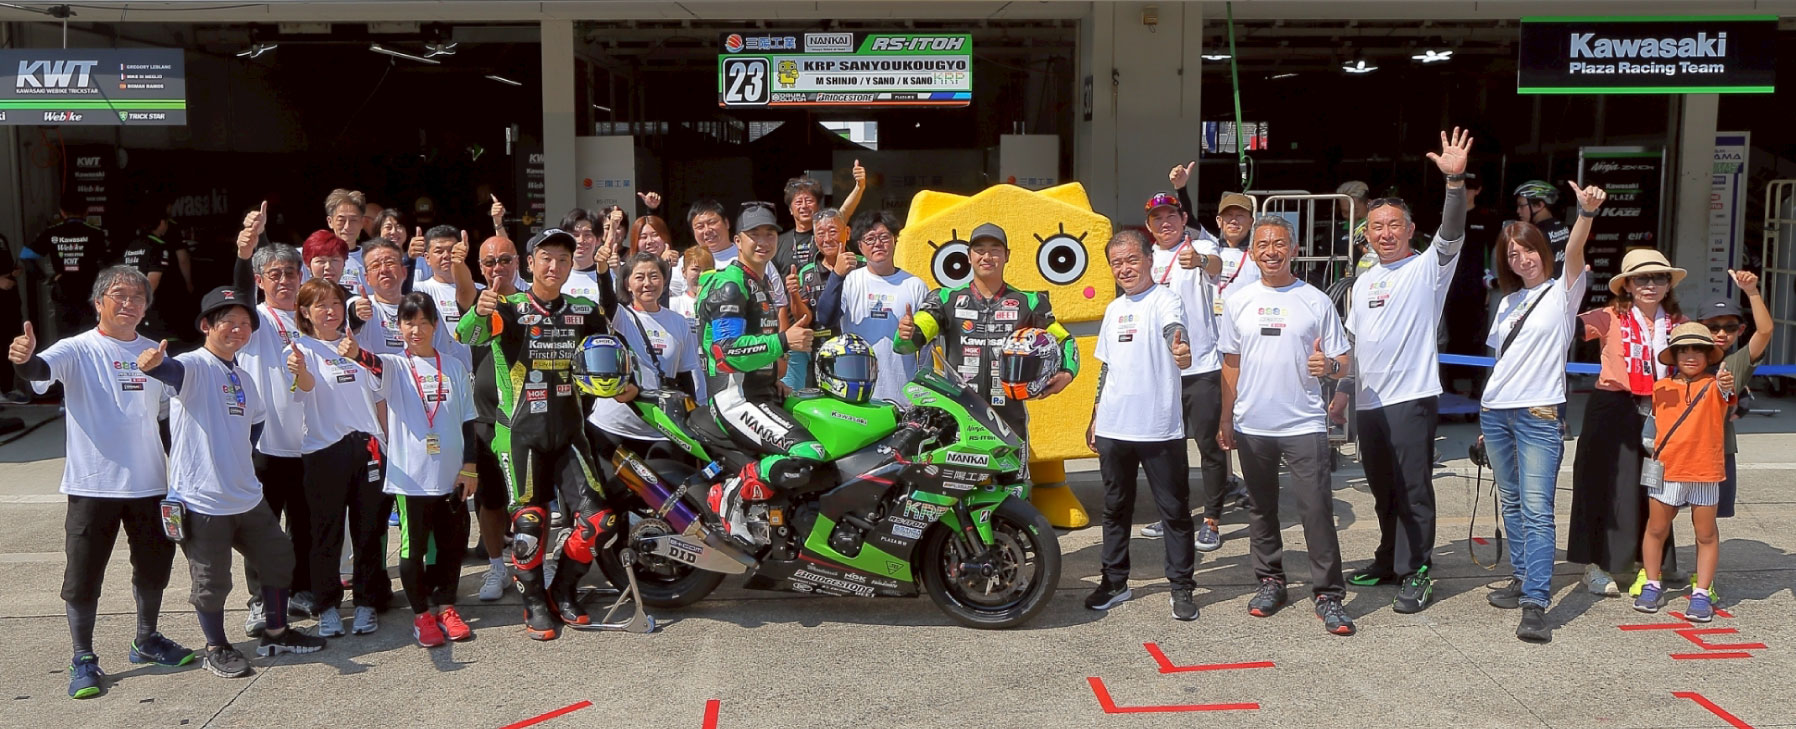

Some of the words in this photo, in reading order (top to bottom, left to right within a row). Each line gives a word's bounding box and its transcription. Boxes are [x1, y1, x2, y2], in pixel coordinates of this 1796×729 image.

[810, 37, 848, 45] NANKAI
[872, 37, 965, 51] RS-ITOH
[1570, 32, 1727, 58] Kawasaki
[804, 61, 836, 71] KRP
[839, 60, 966, 71] SANYOUKOUGYO
[1570, 62, 1615, 74] Plaza
[1618, 62, 1676, 76] Racing
[1679, 61, 1725, 73] Team
[16, 60, 98, 88] KWT
[934, 72, 965, 84] KRP
[726, 62, 765, 102] 23
[816, 77, 825, 85] M
[826, 76, 857, 85] SHINJO
[866, 77, 873, 85] Y
[873, 77, 895, 85] SANO
[903, 77, 909, 85] K
[911, 77, 933, 85] SANO
[817, 93, 874, 102] BRIDGESTONE
[529, 153, 544, 164] KW
[529, 340, 576, 349] Kawasaki
[727, 344, 767, 355] RS-ITOH
[740, 411, 794, 451] NANKAI
[947, 453, 988, 465] NANKAI
[669, 546, 697, 563] DID
